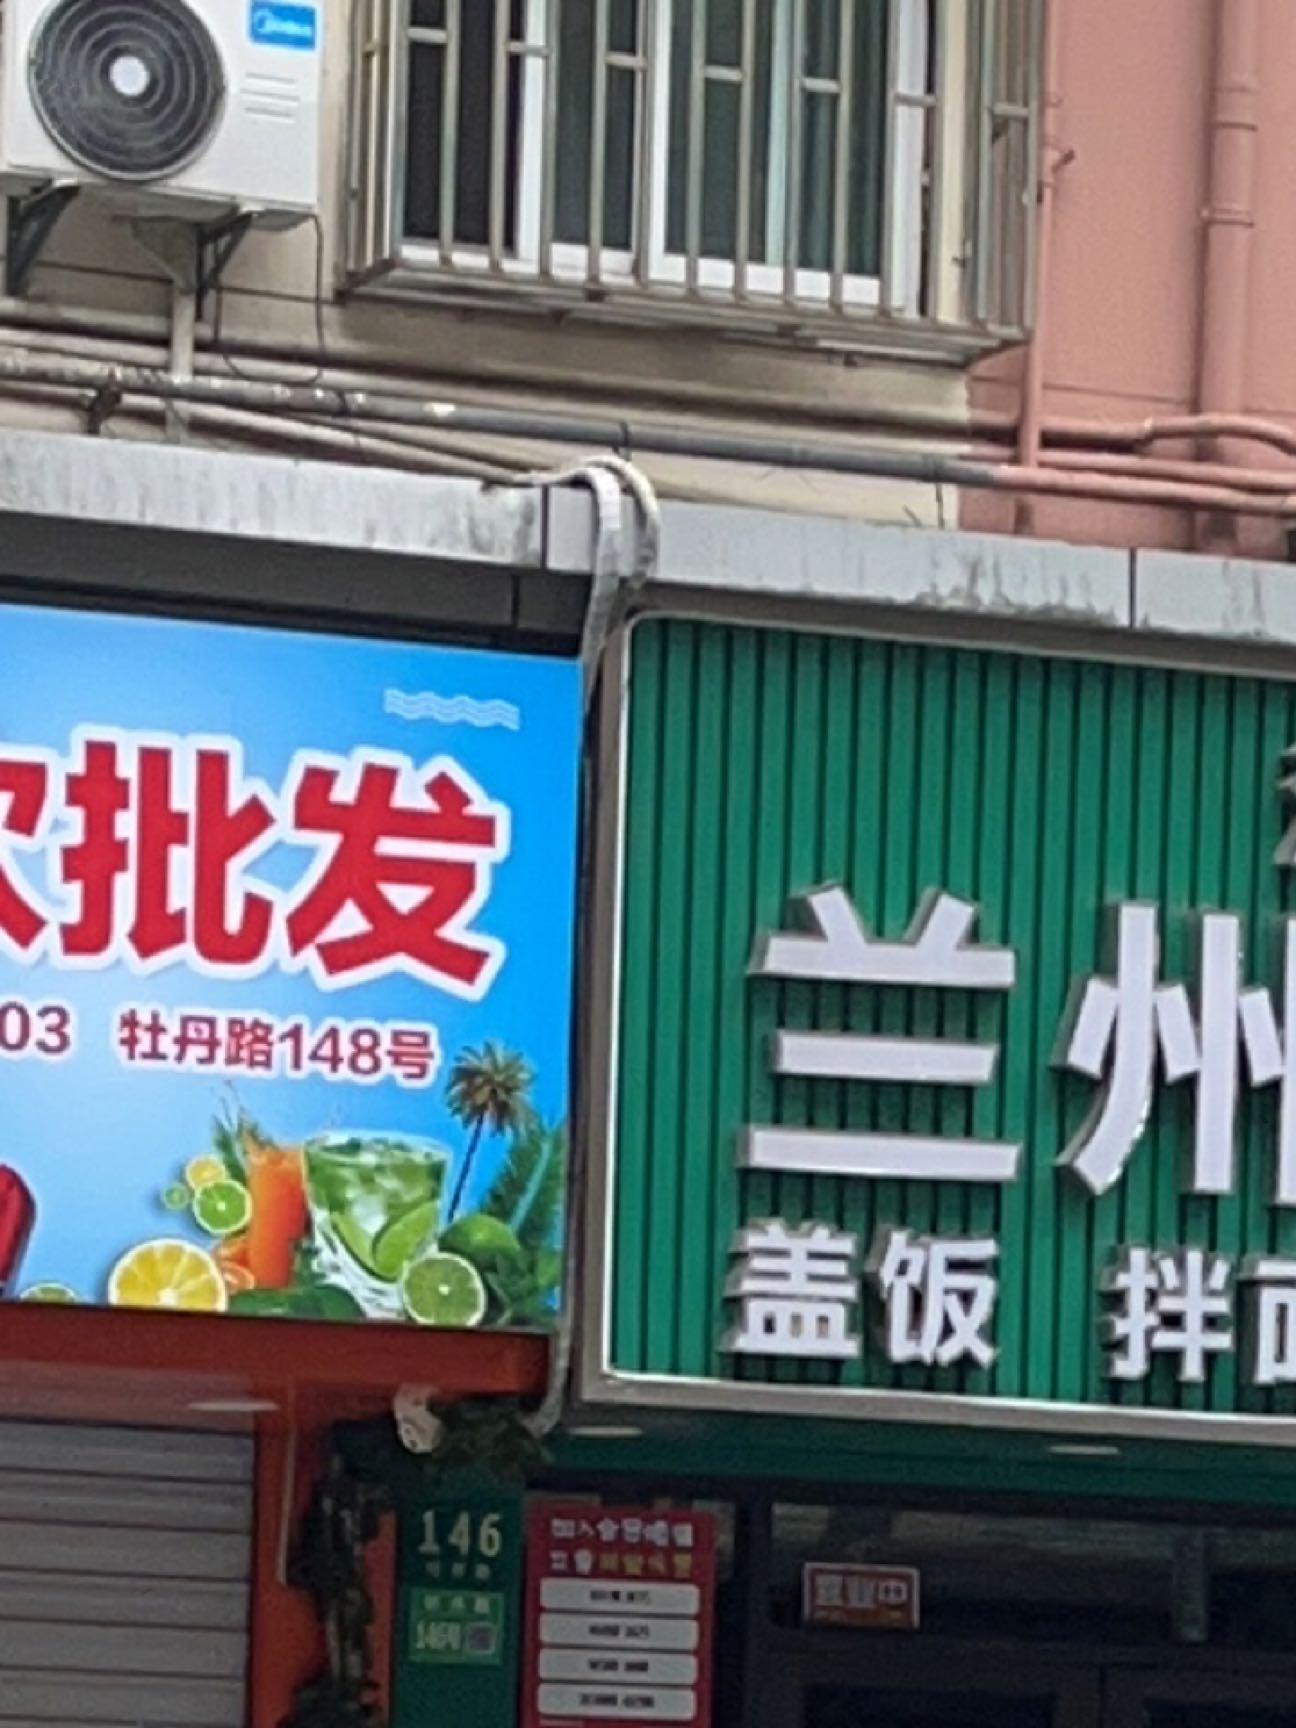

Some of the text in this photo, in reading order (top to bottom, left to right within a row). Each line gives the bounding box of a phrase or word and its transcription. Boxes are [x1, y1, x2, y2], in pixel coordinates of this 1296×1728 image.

[0, 738, 502, 988] 批发
[119, 1007, 435, 1080] 牡丹路148号
[723, 1218, 999, 1368] 盖饭
[418, 1508, 503, 1558] 146
